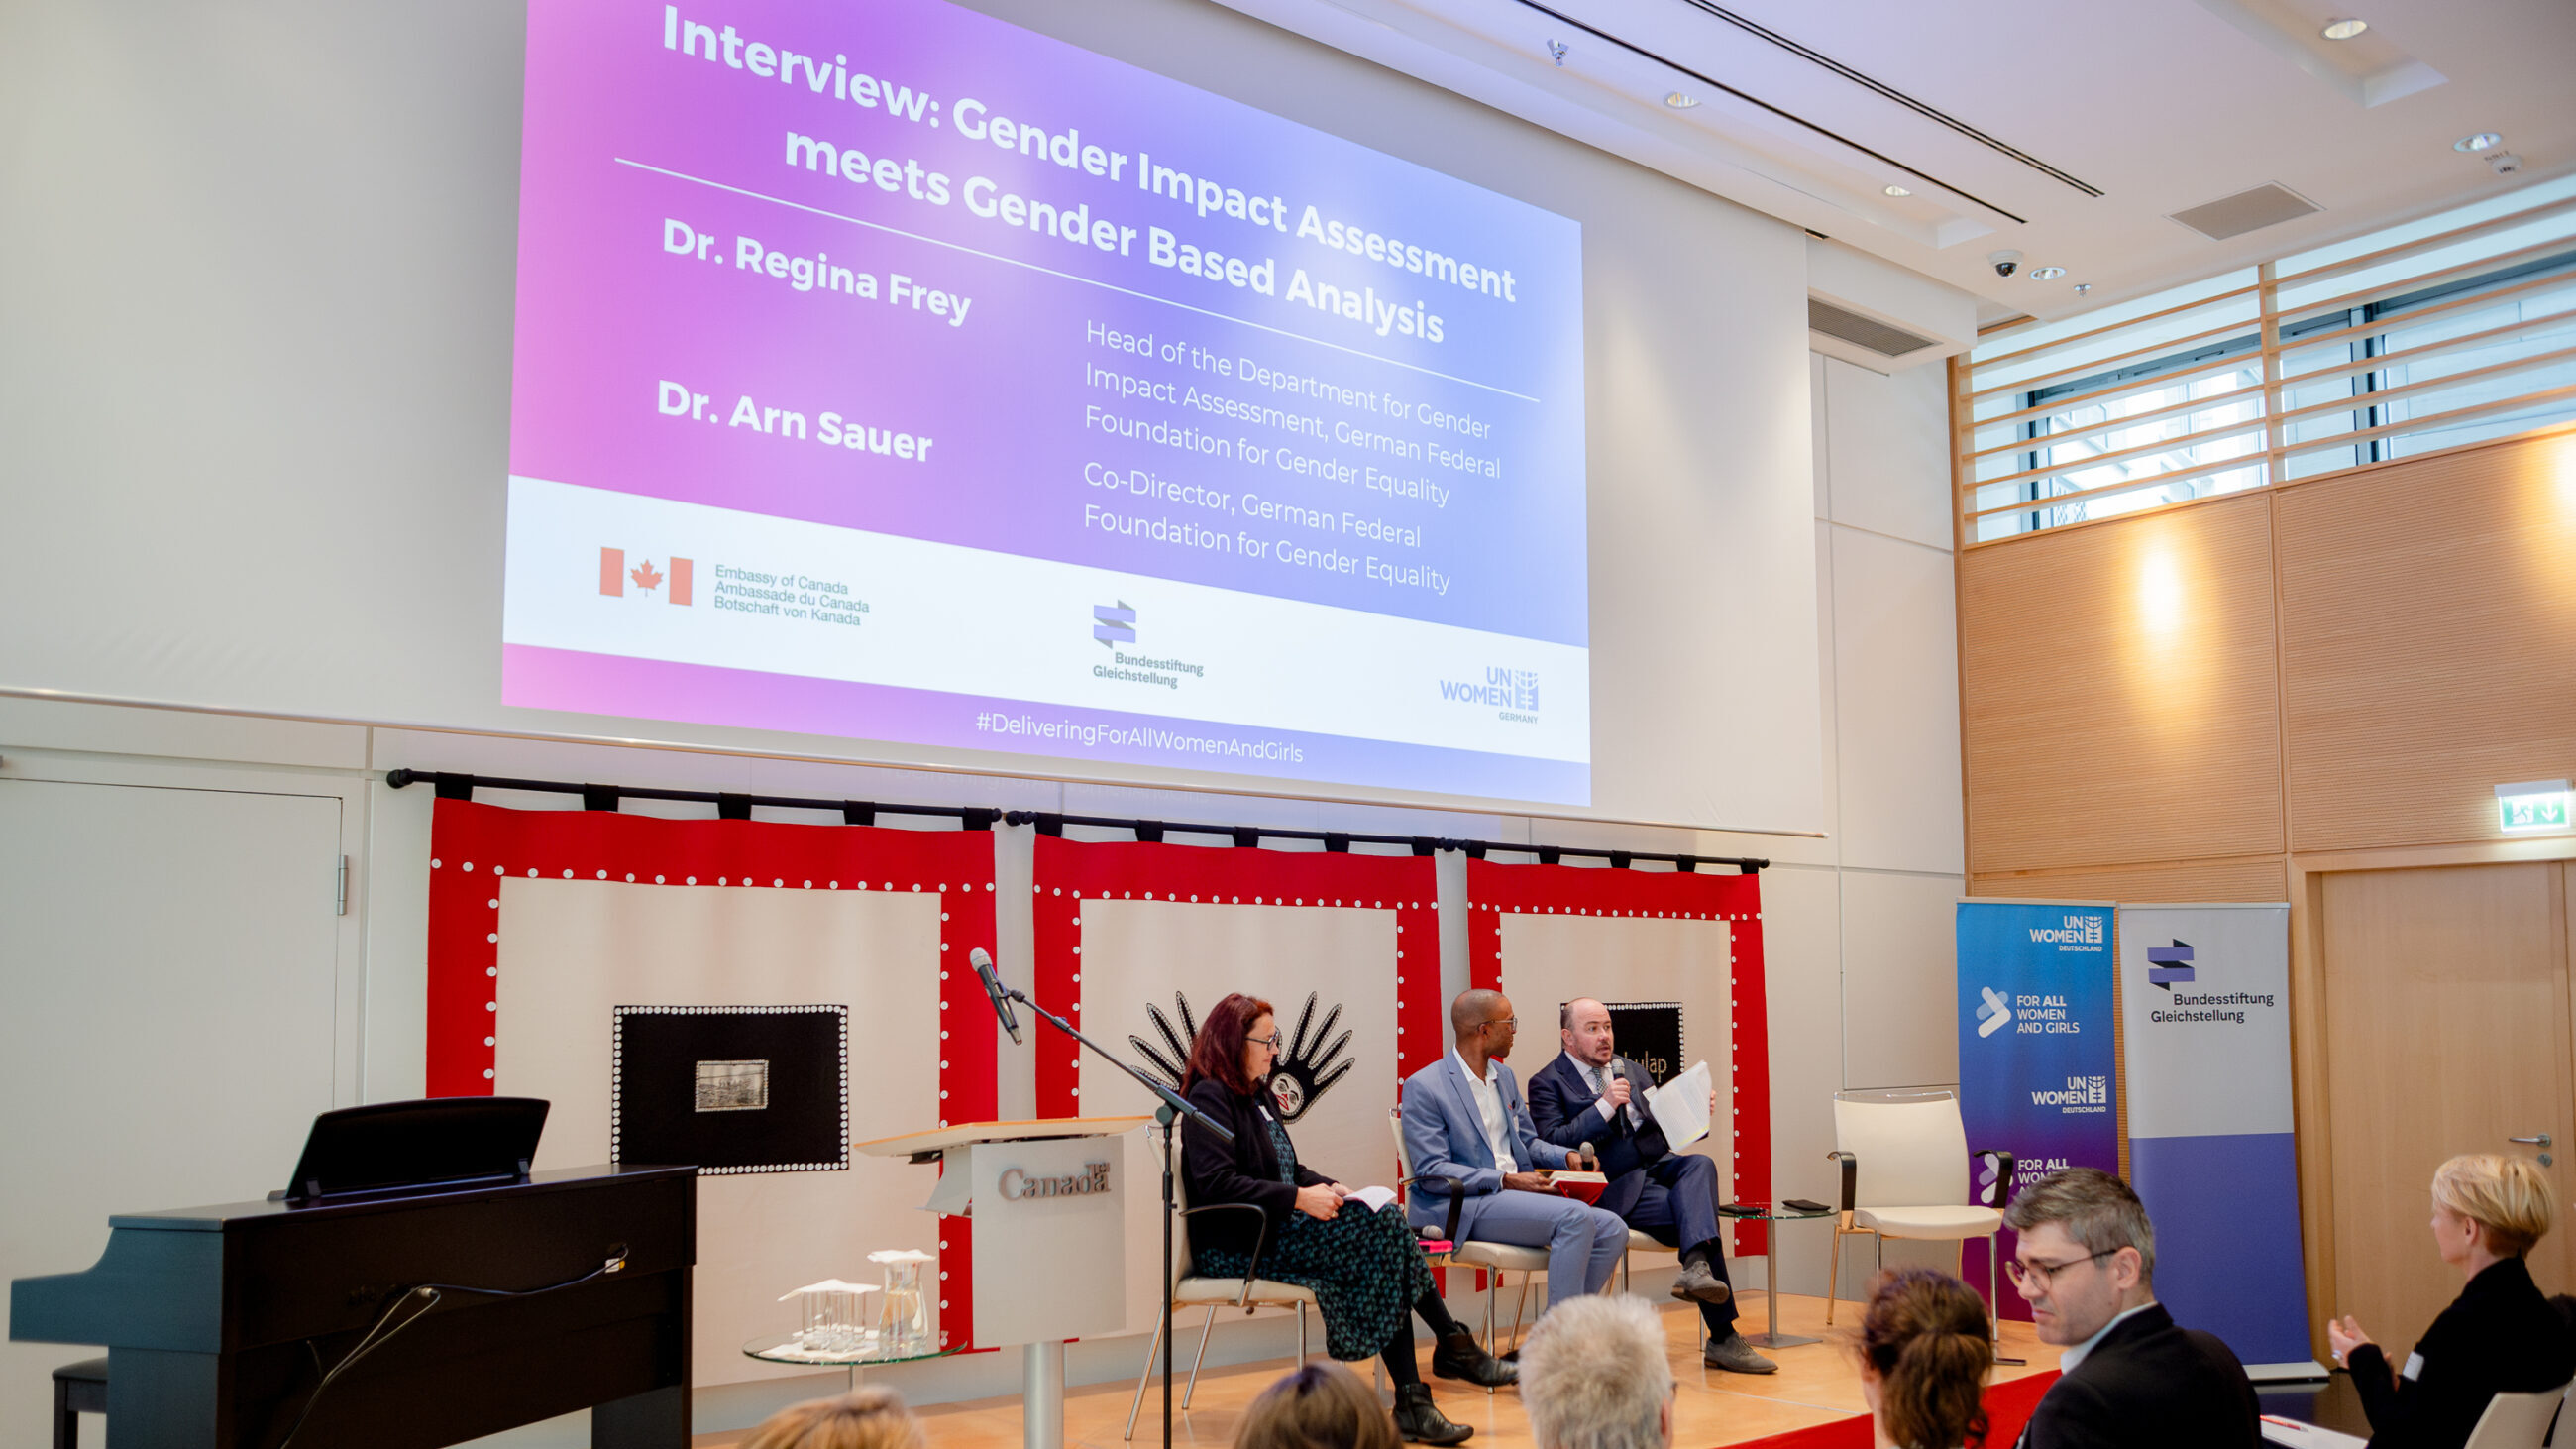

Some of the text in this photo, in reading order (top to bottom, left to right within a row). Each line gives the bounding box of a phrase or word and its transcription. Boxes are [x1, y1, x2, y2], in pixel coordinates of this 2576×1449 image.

[663, 4, 1516, 302] Interview: Gender Impact Assessment
[786, 131, 1444, 344] meets Gender Based Analysis
[663, 217, 972, 327] Dr. Regina Frey
[1087, 319, 1491, 440] Head of the Department for Gender
[657, 379, 933, 462] Dr. Arn Sauer
[1086, 362, 1501, 480] Impact Assessment, German Federal
[1086, 404, 1450, 508] Foundation for Gender Equality
[1084, 461, 1421, 547] Co-Director, German Federal
[1085, 503, 1451, 596] Foundation for Gender Equality
[715, 564, 849, 595] Embassy of Canada
[714, 580, 870, 613] Ambassade du Canada
[714, 595, 861, 626] Botschaft von Kanada
[1093, 665, 1178, 690] Gleichstellung
[1115, 652, 1204, 677] Bundesstiftung
[1486, 666, 1512, 687] UN
[1440, 680, 1512, 708] WOMEN
[1499, 712, 1538, 724] GERMANY
[976, 711, 1304, 763] #DeliveringForAllWomenAndGirls
[2029, 928, 2084, 944] WOMEN
[2064, 915, 2084, 929] UN
[2016, 995, 2067, 1007] FOR ALL
[2016, 1008, 2066, 1020] WOMEN
[2174, 993, 2274, 1007] Bundesstiftung
[2016, 1022, 2080, 1034] AND GIRLS
[2151, 1009, 2244, 1024] Gleichstellung
[2067, 1076, 2087, 1090] UN
[2031, 1090, 2087, 1105] WOMEN
[2018, 1158, 2070, 1170] FOR ALL
[998, 1162, 1111, 1202] Canada
